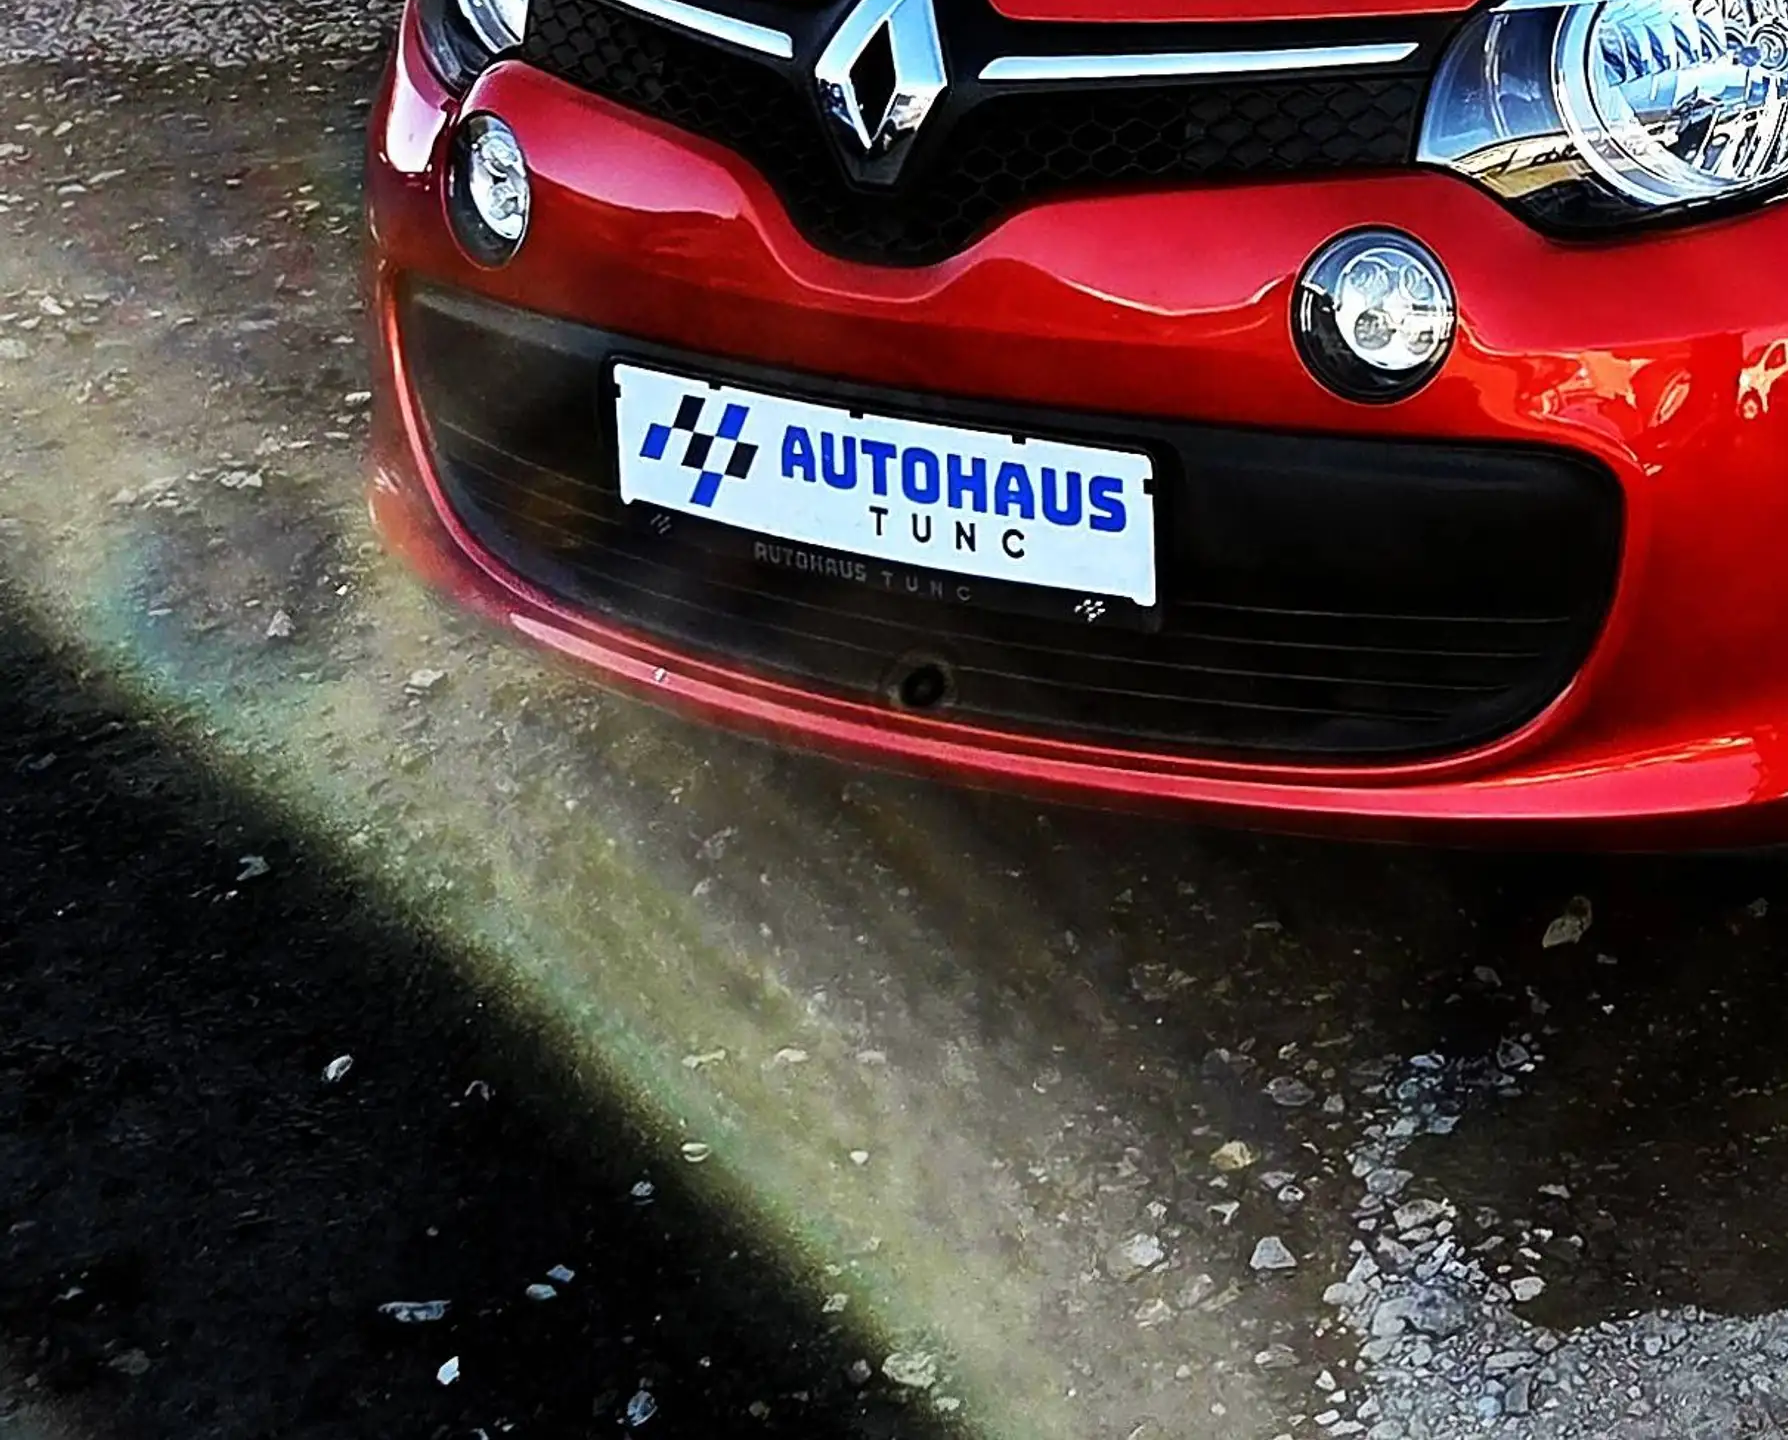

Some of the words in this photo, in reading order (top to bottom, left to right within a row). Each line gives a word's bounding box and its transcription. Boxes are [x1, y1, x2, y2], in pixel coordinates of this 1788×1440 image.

[781, 424, 1127, 533] AUTOHAUS
[869, 506, 1026, 559] TUNC
[754, 541, 868, 583] AUTOHAUS
